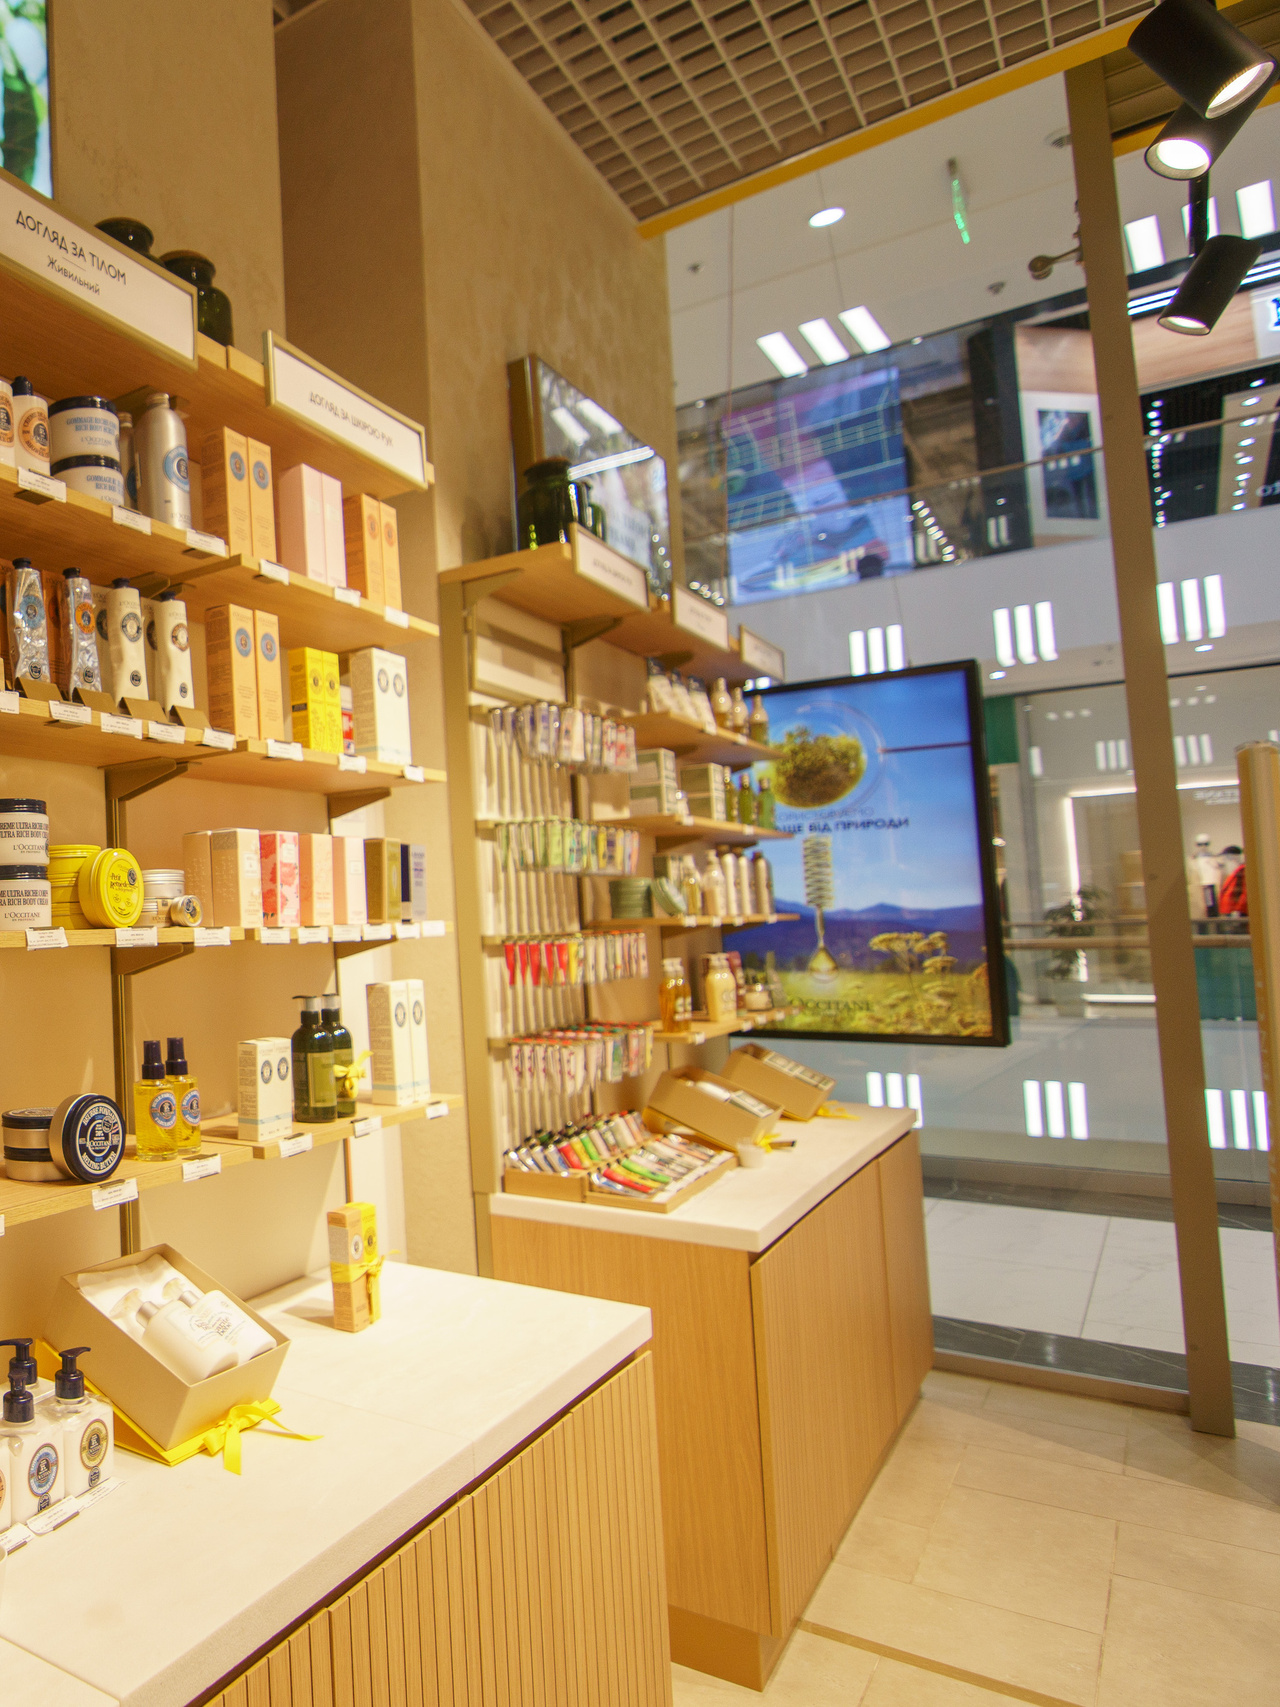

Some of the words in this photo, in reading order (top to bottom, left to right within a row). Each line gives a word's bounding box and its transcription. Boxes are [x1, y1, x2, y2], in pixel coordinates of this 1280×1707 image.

[16, 209, 70, 255] ДОГЛЯД
[71, 241, 87, 263] ЗА
[89, 251, 127, 287] ТІЛОМ
[47, 254, 101, 297] Живильний
[835, 816, 910, 832] ПРИРОДИ
[16, 830, 30, 839] RICH
[6, 890, 24, 898] ULTRA
[7, 899, 22, 907] RICH
[23, 898, 37, 907] BODY
[4, 911, 41, 919] L'OCCITANE
